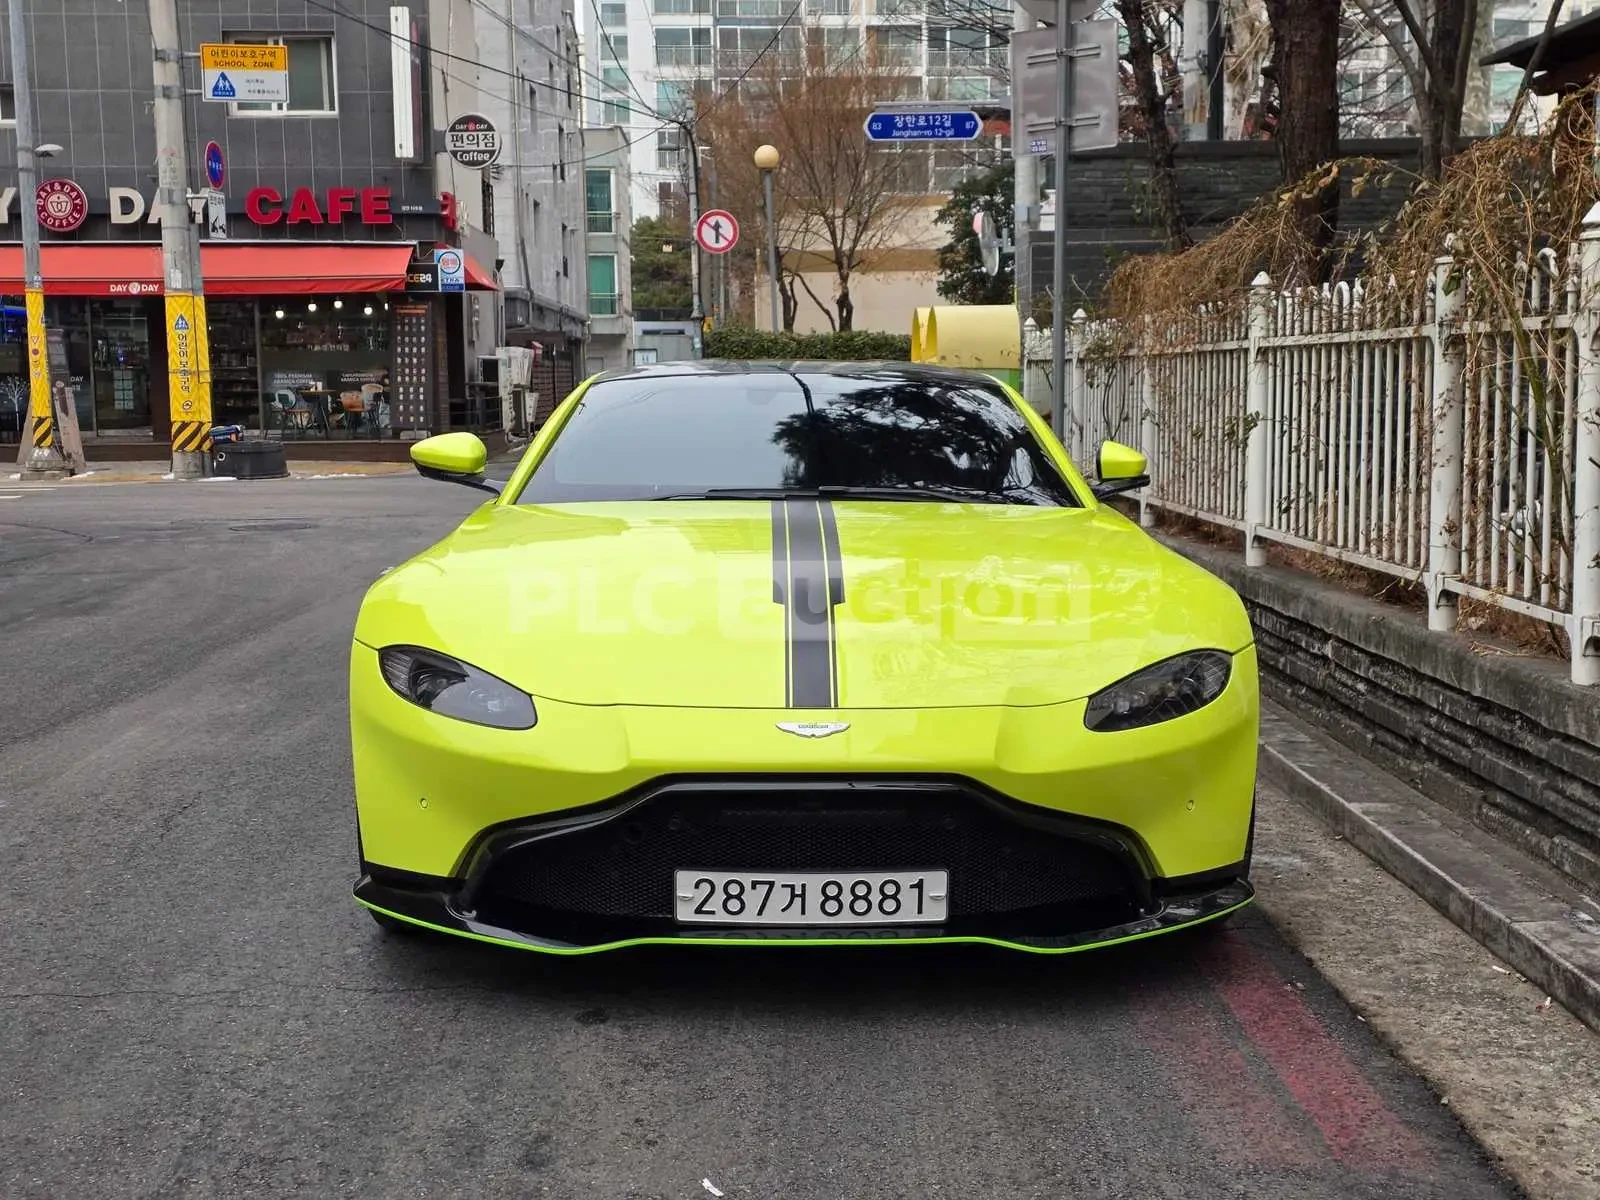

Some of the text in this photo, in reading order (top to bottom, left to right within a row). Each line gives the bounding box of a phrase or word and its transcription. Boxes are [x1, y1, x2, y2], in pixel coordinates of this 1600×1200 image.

[210, 49, 277, 60] 어린이보호구역
[213, 60, 275, 68] SCHOOL ZONE
[450, 133, 495, 148] 편의점
[457, 151, 490, 161] Coffee
[245, 187, 393, 225] CAFE
[40, 210, 81, 227] COFFEE
[110, 284, 159, 292] DAY DAY
[694, 878, 924, 917] 287거 8881
